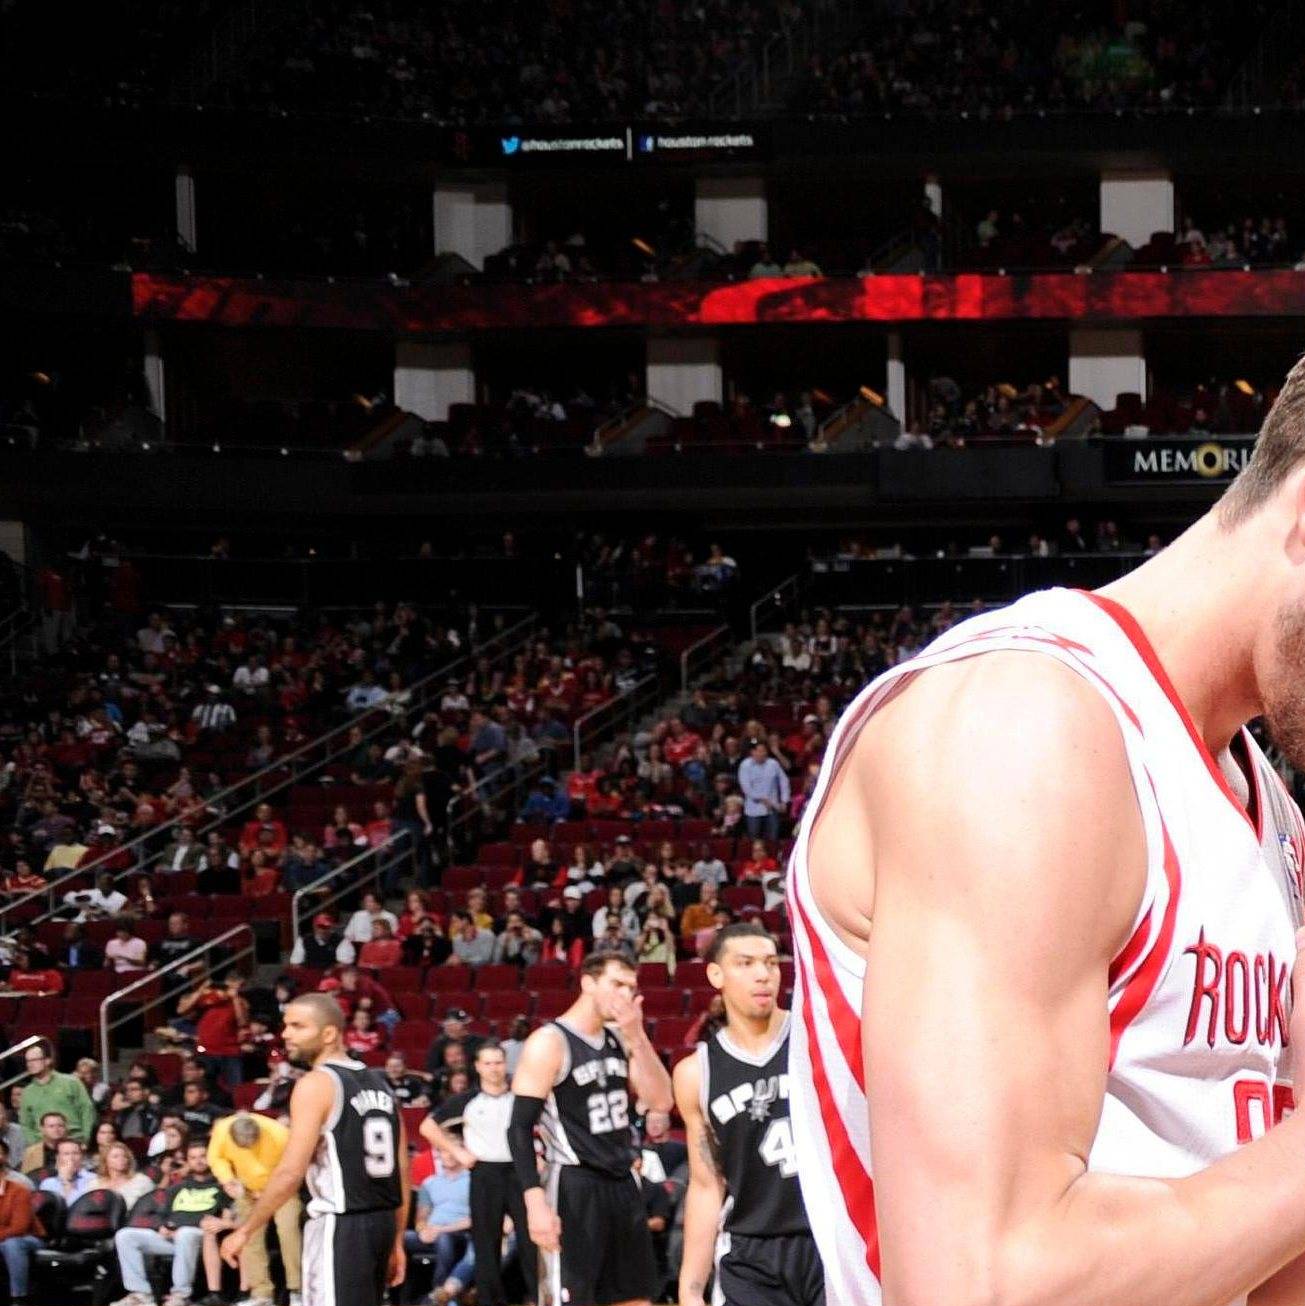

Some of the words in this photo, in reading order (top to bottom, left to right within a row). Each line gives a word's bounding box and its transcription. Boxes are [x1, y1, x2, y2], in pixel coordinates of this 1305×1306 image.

[1134, 443, 1251, 477] MEMORI
[1182, 924, 1290, 1050] ROCK
[587, 1089, 629, 1134] 22
[363, 1117, 394, 1178] 9
[758, 1116, 799, 1179] 4
